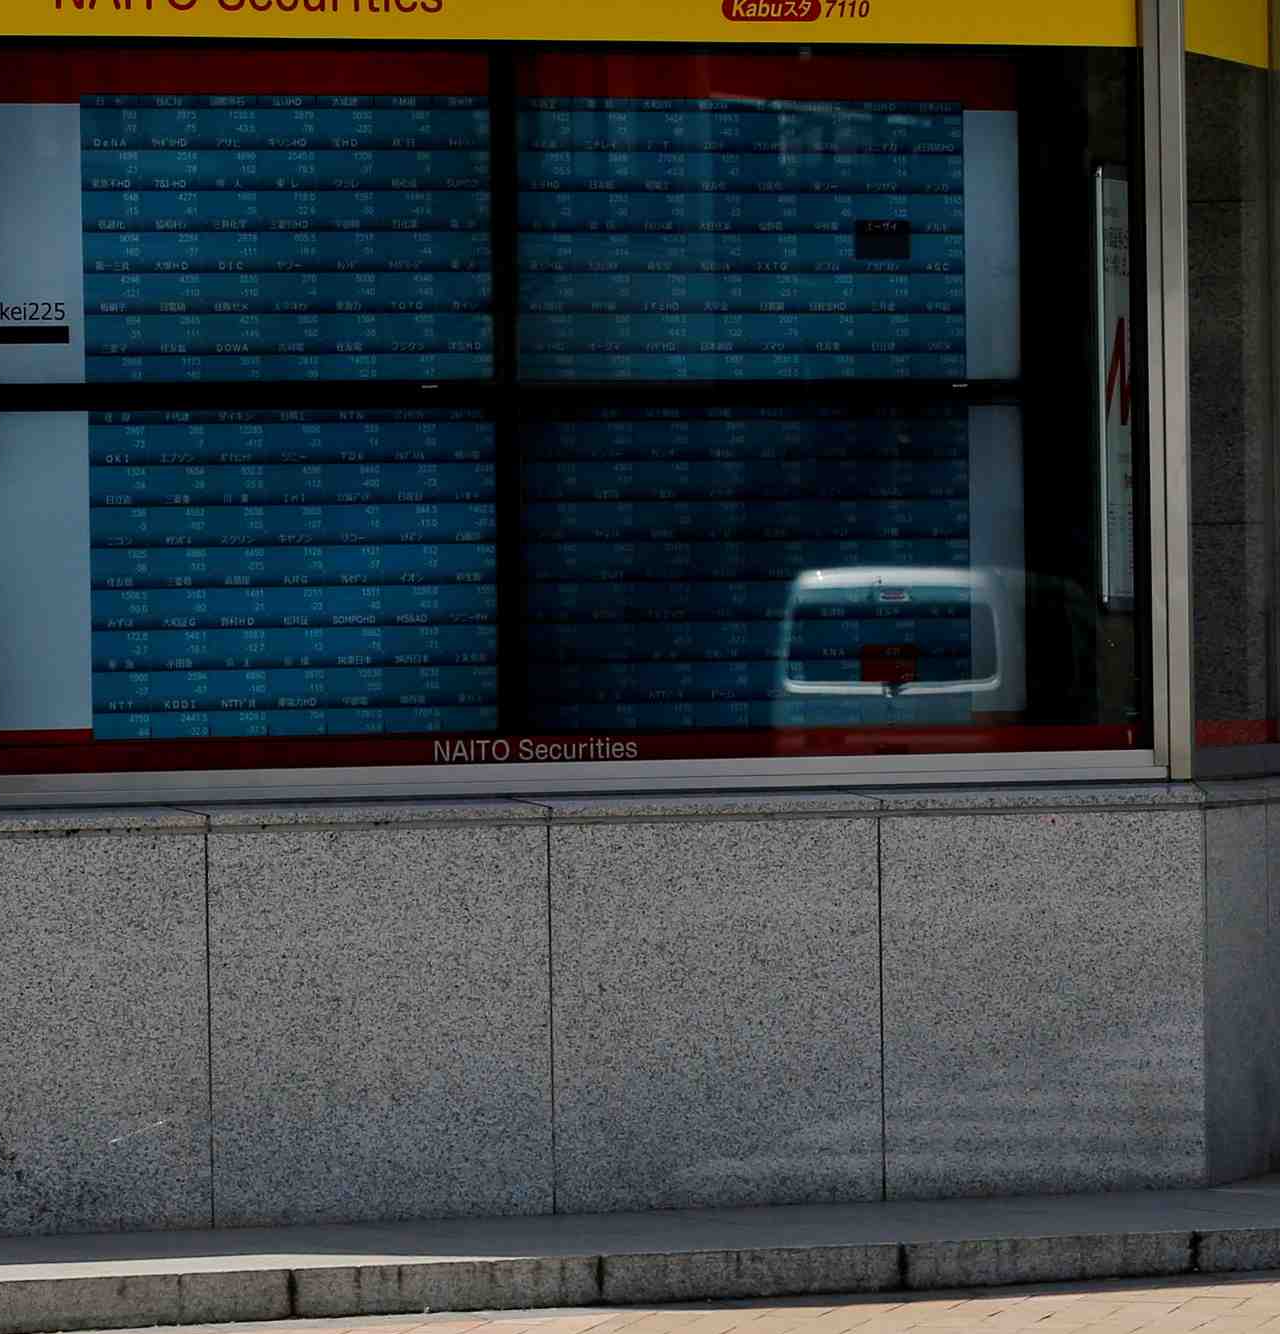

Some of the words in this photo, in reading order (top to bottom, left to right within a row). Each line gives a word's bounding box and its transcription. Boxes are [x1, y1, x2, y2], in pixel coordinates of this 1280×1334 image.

[825, 0, 870, 17] 7110
[433, 739, 511, 763] NAITO
[519, 737, 638, 760] Securities
